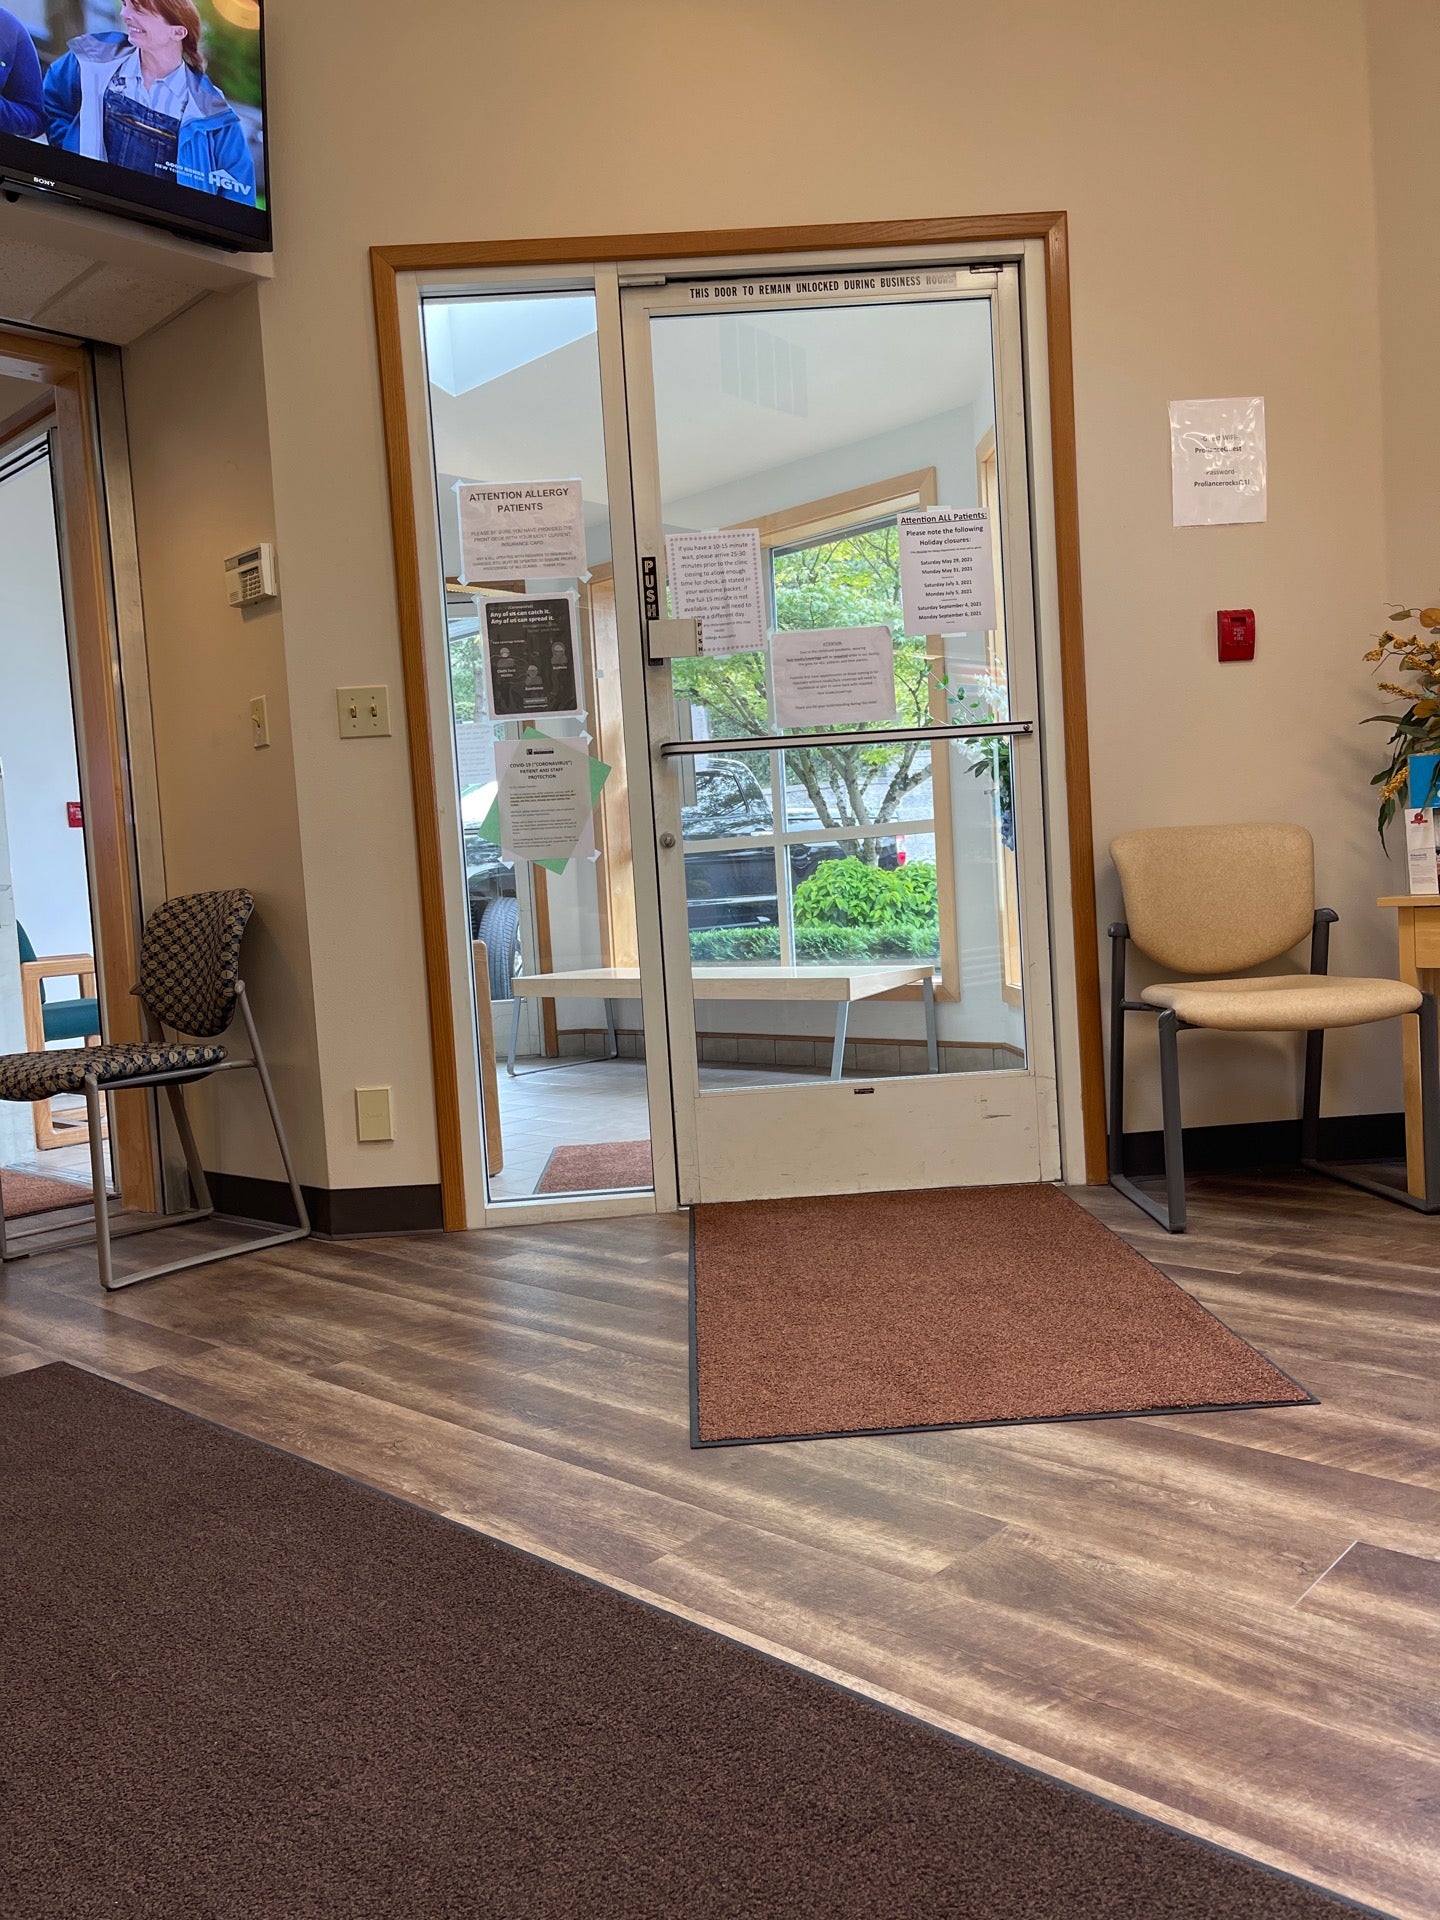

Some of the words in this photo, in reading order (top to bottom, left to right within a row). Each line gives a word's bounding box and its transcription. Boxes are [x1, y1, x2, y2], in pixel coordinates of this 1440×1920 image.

[33, 176, 56, 188] SONY
[208, 171, 251, 196] HGTV
[689, 288, 710, 299] THIS
[714, 286, 738, 298] DOOR
[742, 285, 754, 296] TO
[759, 283, 791, 295] REMAIN
[796, 280, 839, 293] UNLOCKED
[844, 278, 876, 290] DURING
[880, 275, 921, 288] BUSINESS
[469, 491, 522, 502] ATTENTION
[525, 488, 569, 499] ALLERGY
[497, 503, 544, 513] PATIENTS
[901, 516, 937, 524] Attention
[938, 514, 952, 522] ALL
[954, 525, 984, 533] following
[644, 560, 657, 618] PUSH
